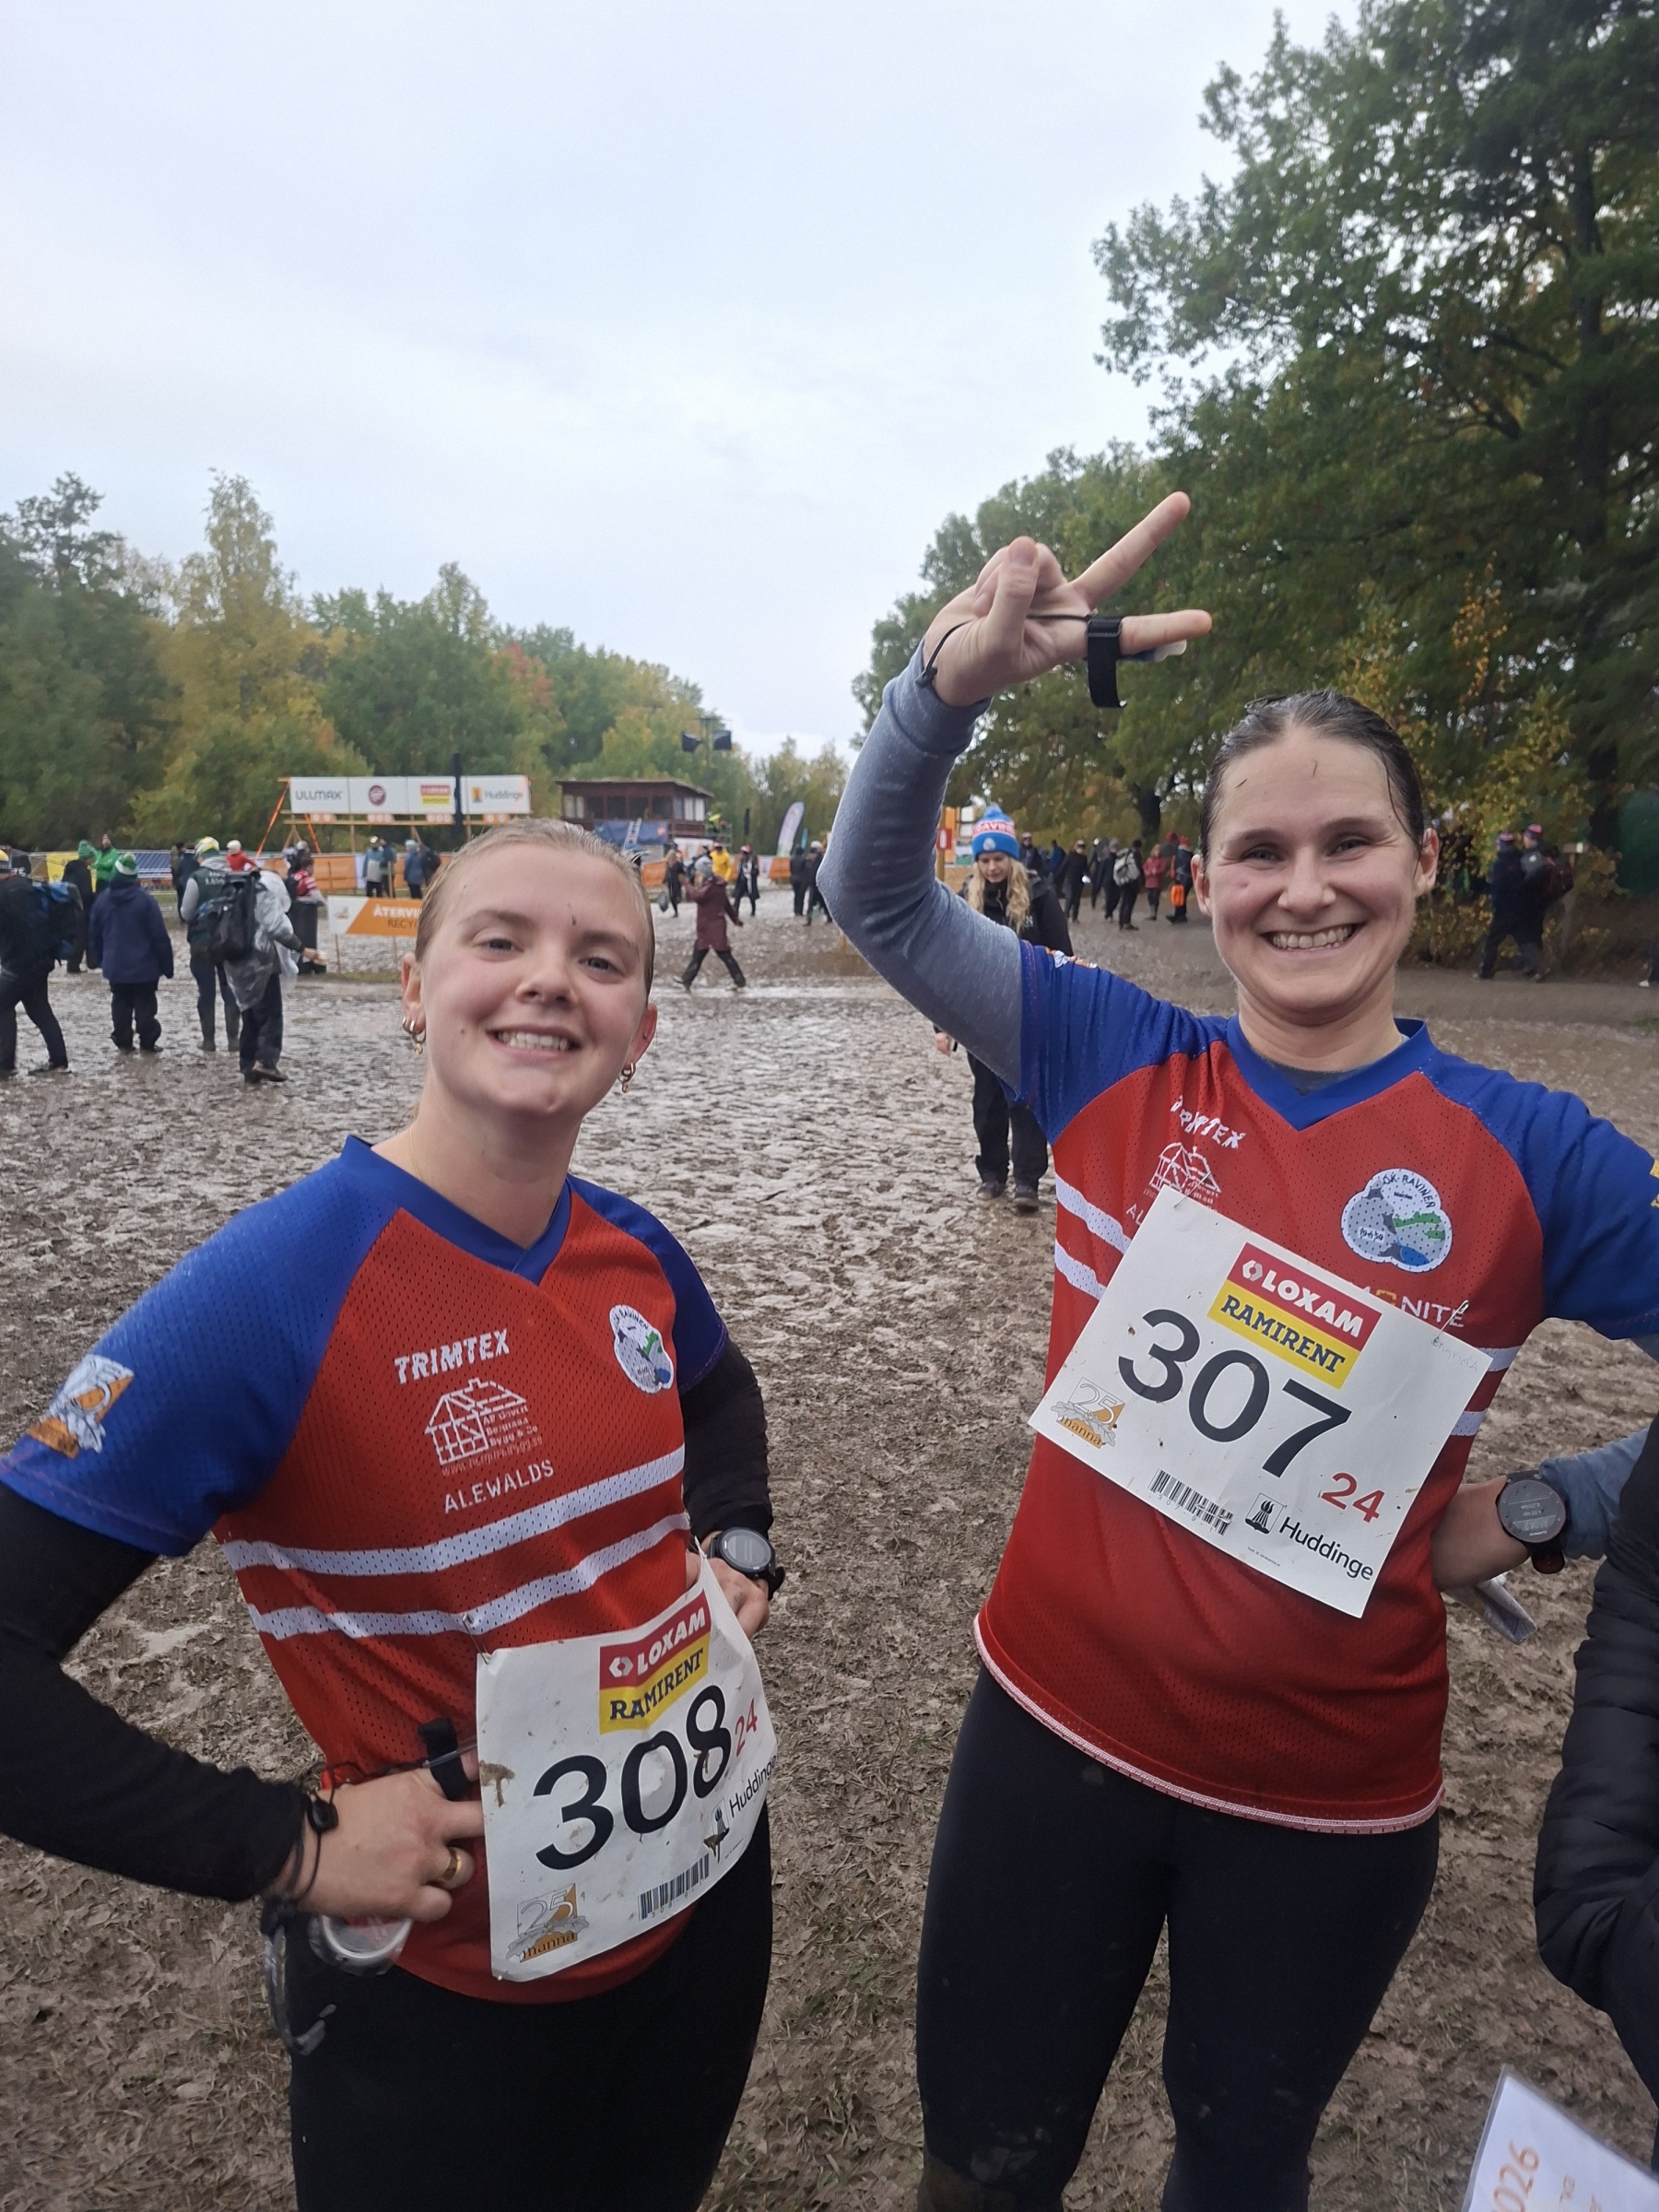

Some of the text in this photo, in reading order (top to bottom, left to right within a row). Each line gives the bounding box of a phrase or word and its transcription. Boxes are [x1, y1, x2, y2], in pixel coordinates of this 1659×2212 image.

[373, 903, 421, 918] ÅTERVI
[388, 919, 418, 928] RECY
[1402, 1174, 1436, 1208] RAVINEN
[1262, 1269, 1364, 1337] LOXAM
[394, 1329, 510, 1384] TRIMTEX
[1219, 1294, 1346, 1374] RAMIRENT
[1073, 1382, 1117, 1424] 25
[1118, 1309, 1352, 1478] 307
[489, 1433, 515, 1448] Bygg
[1061, 1417, 1102, 1445] manna
[445, 1459, 554, 1513] ALEWALDS
[1321, 1472, 1385, 1524] 24
[1279, 1516, 1373, 1580] Huddinge
[637, 1606, 706, 1677] LOXAM
[609, 1648, 704, 1721] RAMIRENT
[735, 1697, 759, 1758] 24
[533, 1685, 733, 1870] 308
[728, 1754, 778, 1818] Huddinge
[521, 1889, 574, 1935] 25
[523, 1933, 575, 1959] manna
